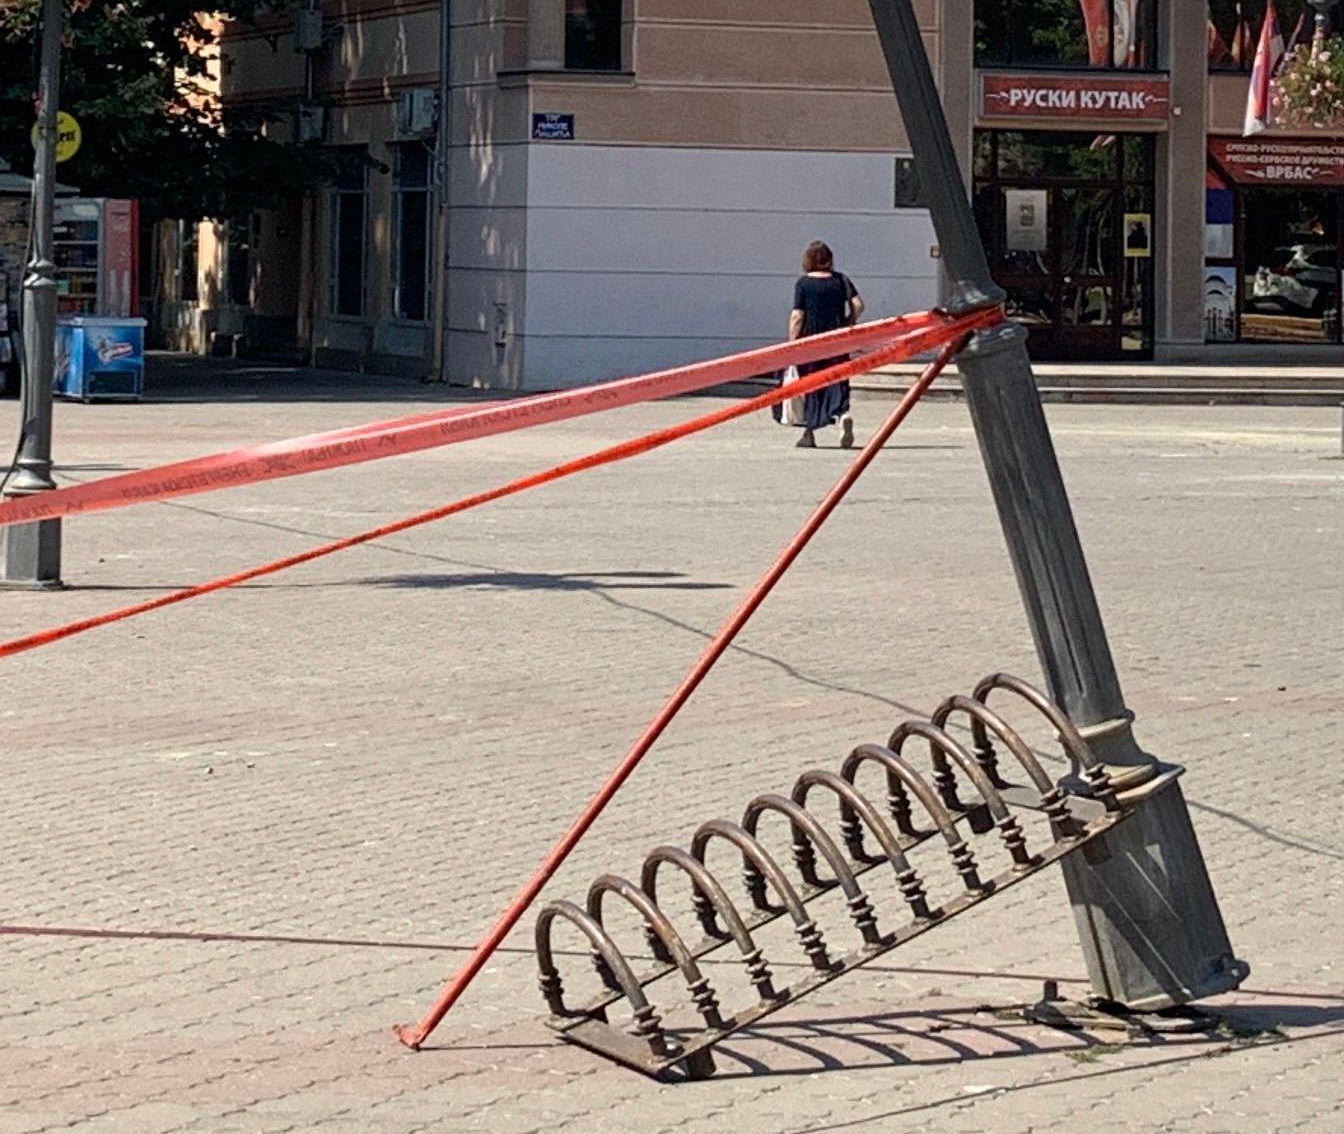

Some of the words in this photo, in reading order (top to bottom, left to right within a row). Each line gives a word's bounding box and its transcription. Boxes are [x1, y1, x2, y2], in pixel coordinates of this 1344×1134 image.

[1009, 88, 1076, 108] РУСКИ
[1080, 90, 1146, 110] КУТАК
[1266, 166, 1314, 180] ВРБАС
